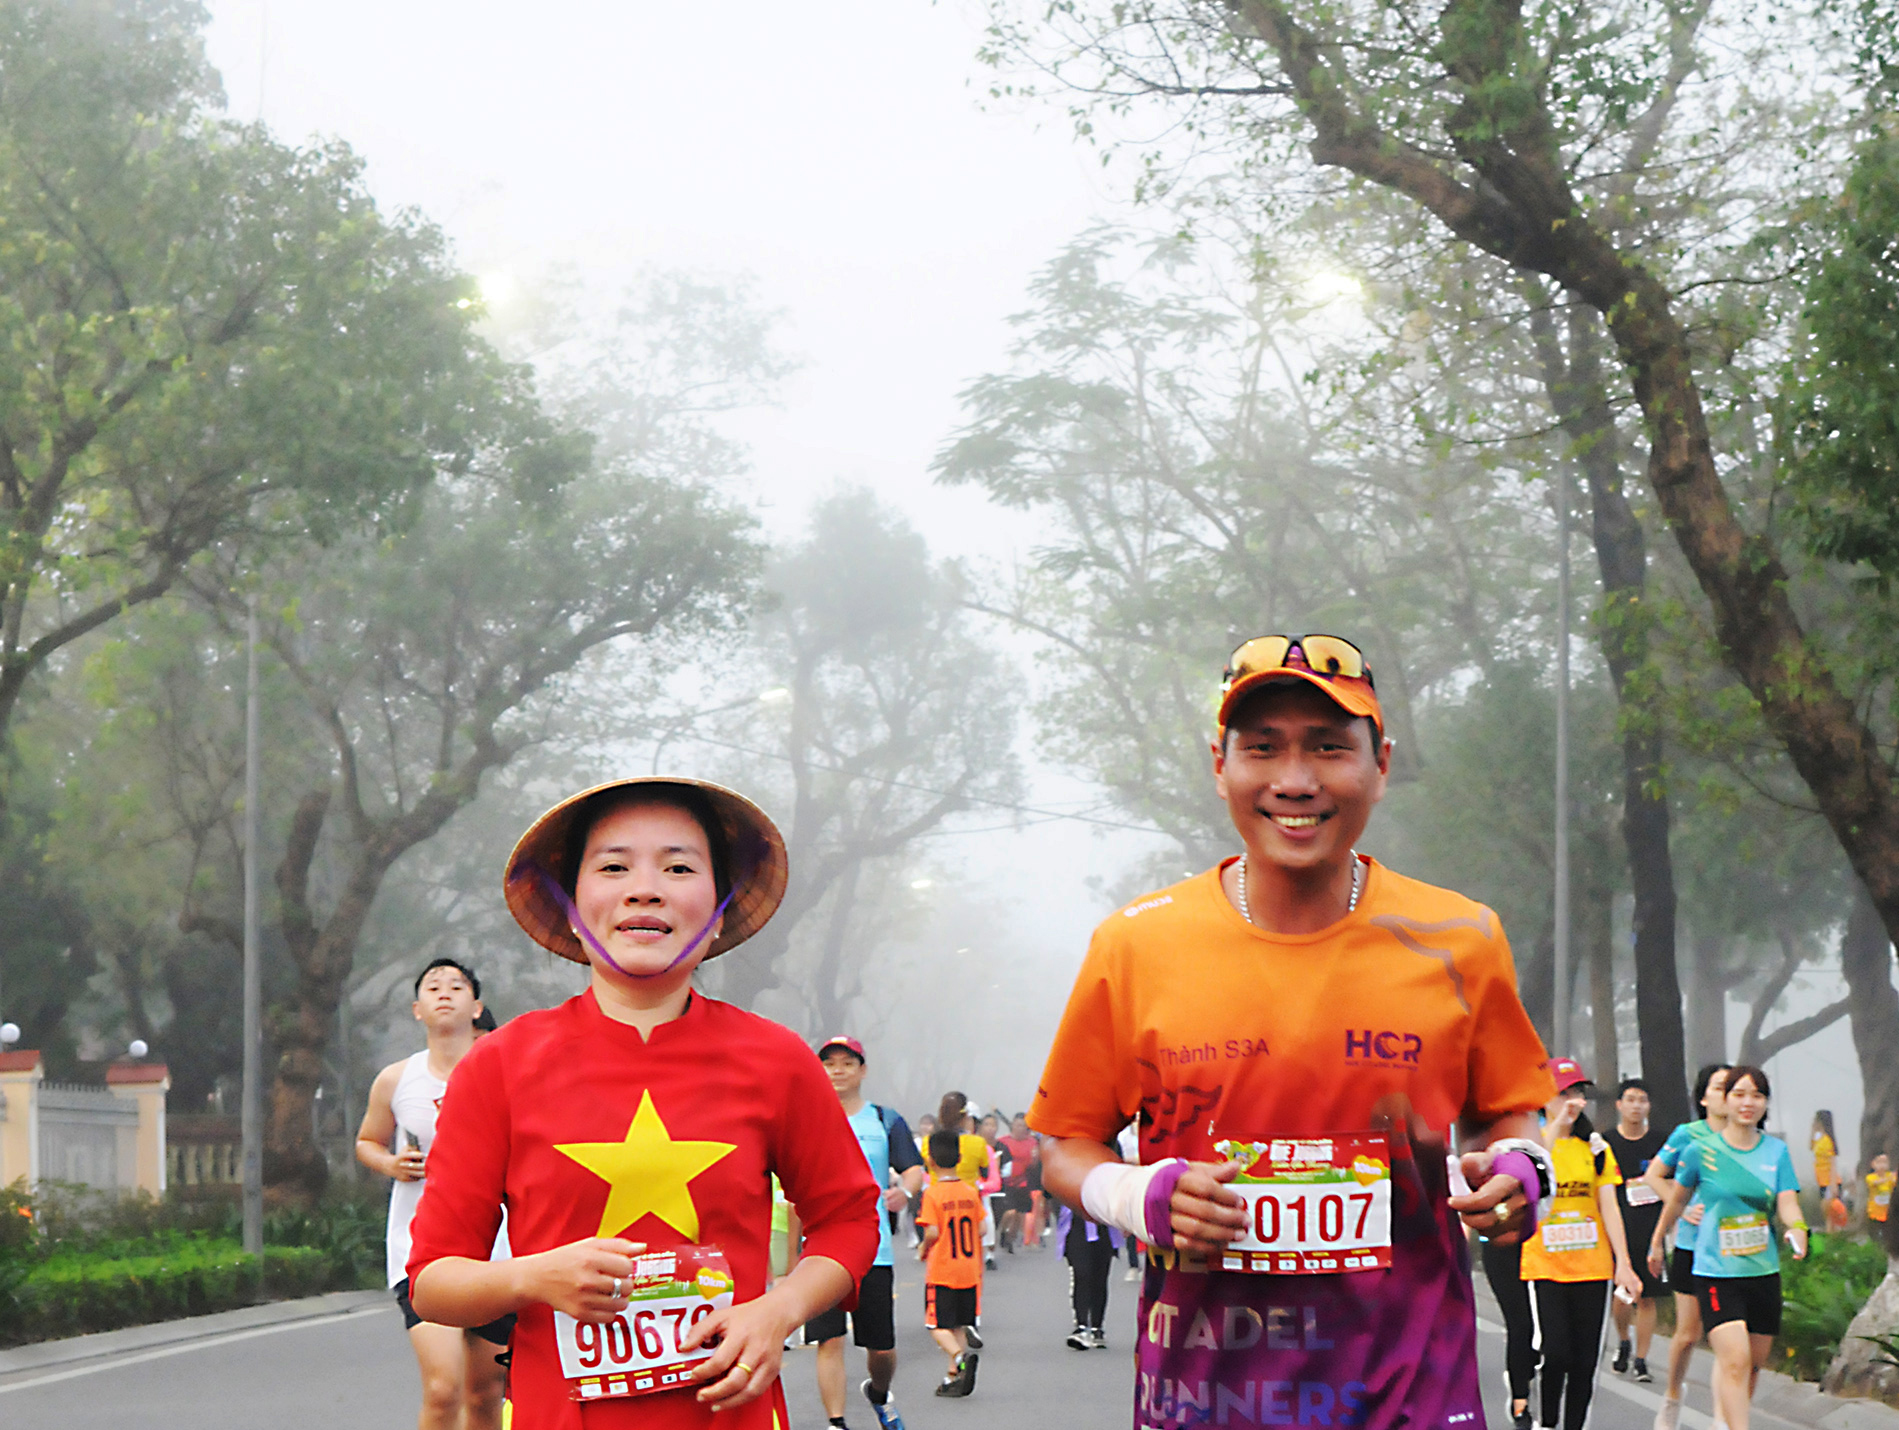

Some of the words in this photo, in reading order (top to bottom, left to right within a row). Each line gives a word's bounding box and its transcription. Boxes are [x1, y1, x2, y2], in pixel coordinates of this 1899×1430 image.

[1159, 1042, 1218, 1066] Thành
[1224, 1038, 1270, 1059] S3A
[1345, 1030, 1422, 1065] HCR
[947, 1215, 974, 1259] 10
[1232, 1192, 1374, 1244] 0107
